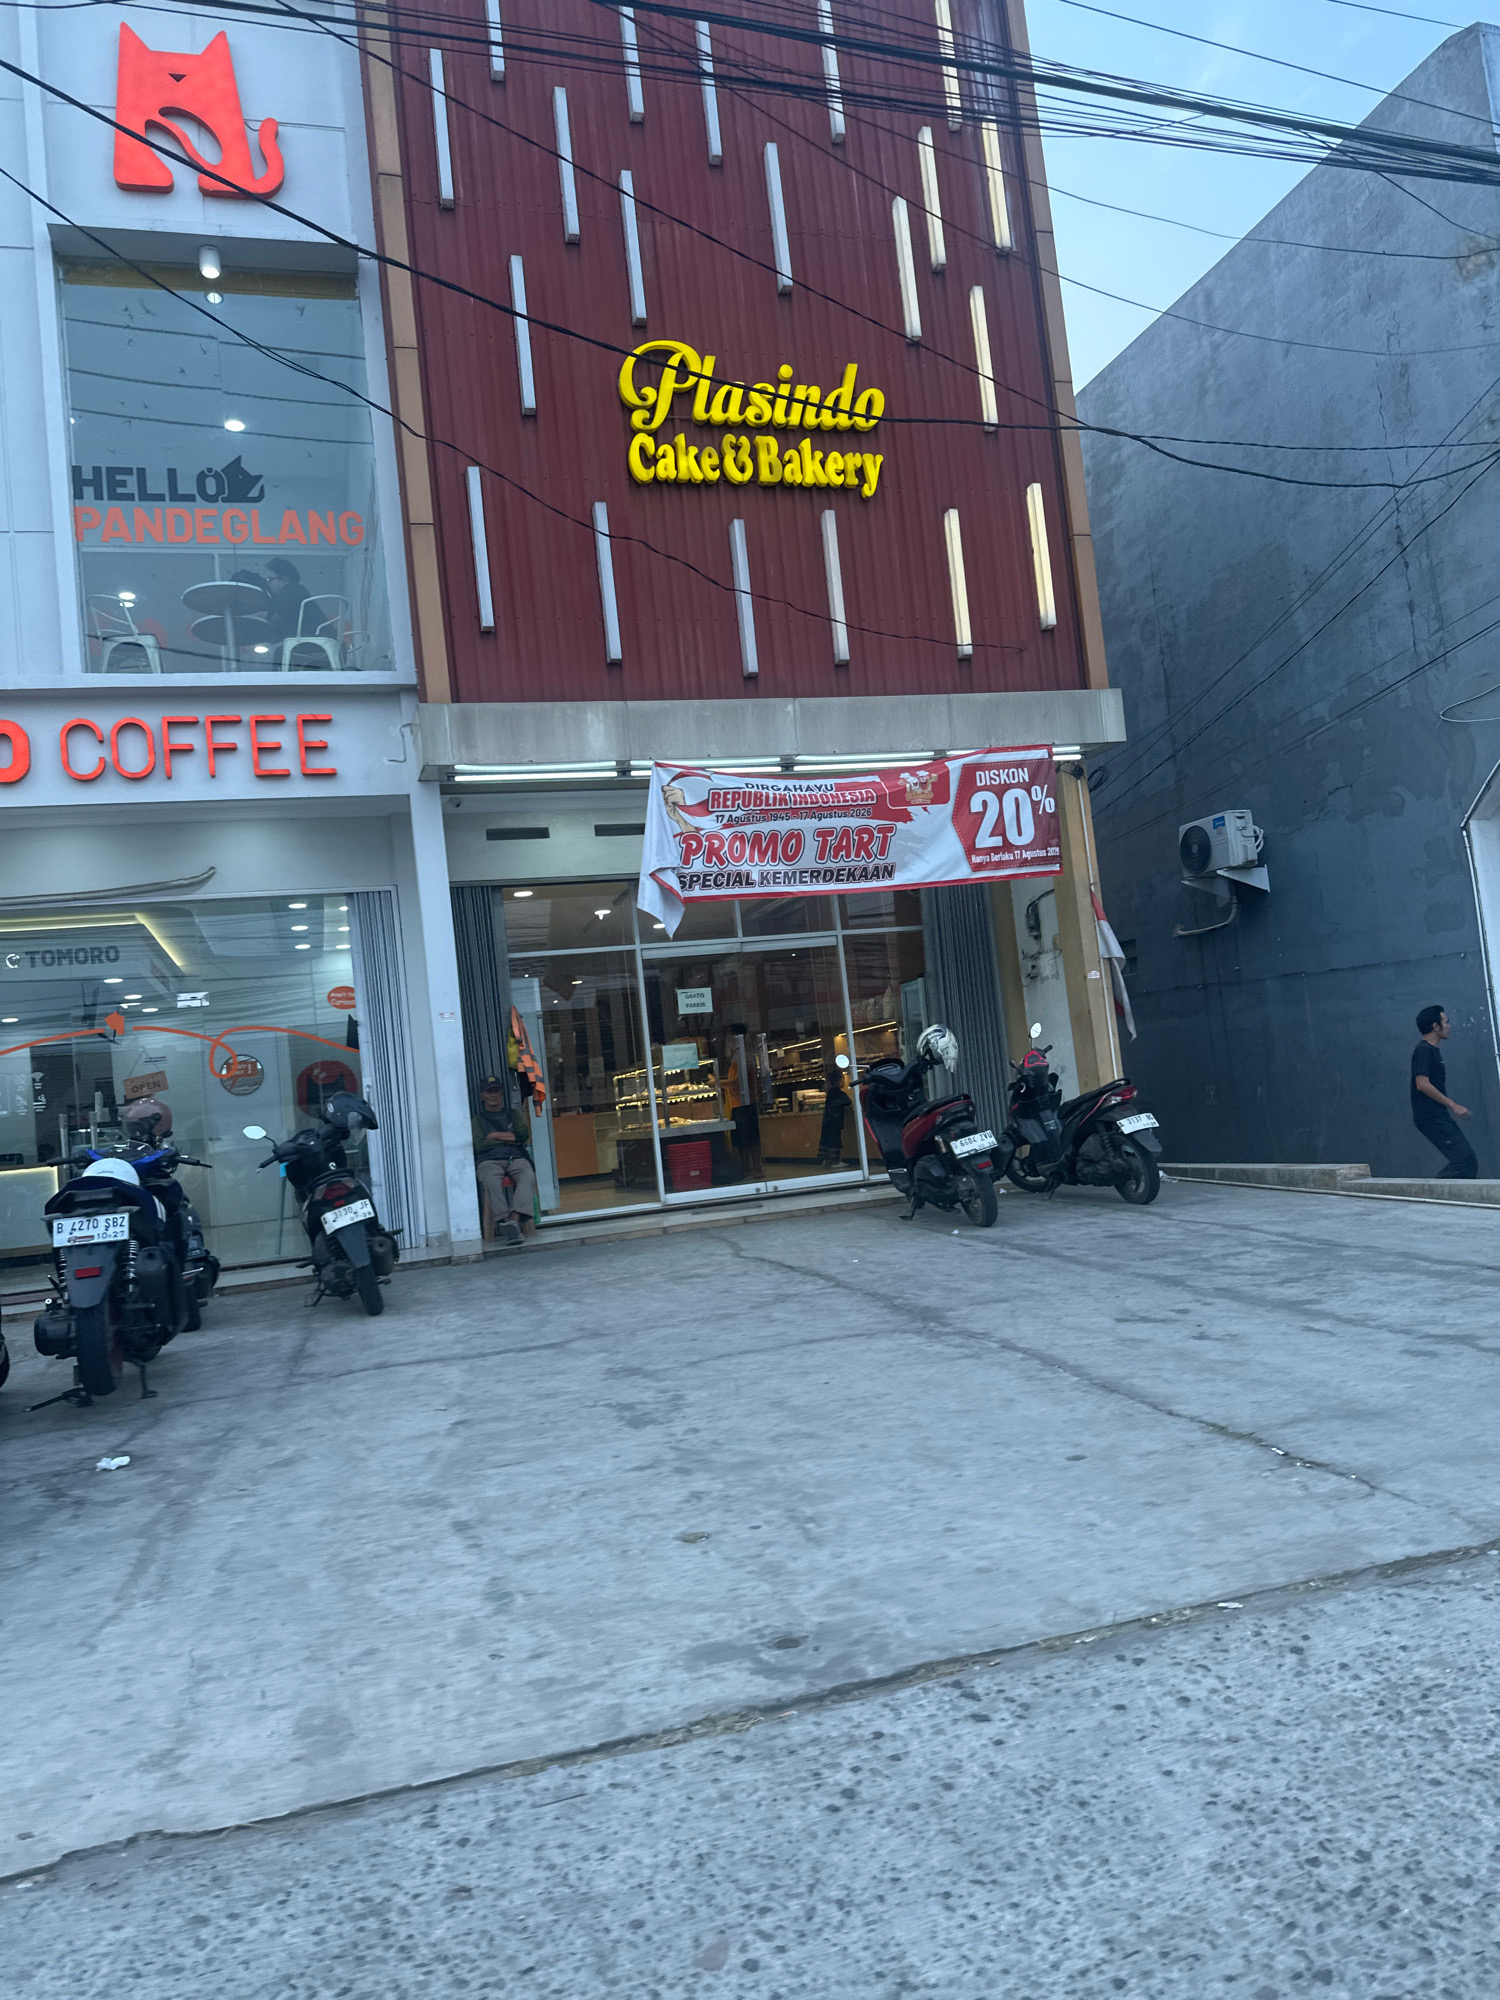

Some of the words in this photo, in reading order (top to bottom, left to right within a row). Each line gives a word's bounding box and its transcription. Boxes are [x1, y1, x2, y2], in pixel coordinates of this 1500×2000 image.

[619, 340, 885, 433] Plasindo
[72, 465, 228, 503] HELLO
[73, 506, 365, 546] PANDEGLANG
[60, 714, 337, 781] COFFEE
[745, 782, 834, 793] DIRGAHAYU
[976, 767, 1030, 786] DISKON
[710, 790, 790, 810] REPUBLIK
[791, 789, 876, 807] INDONESIA
[715, 814, 725, 824] 17
[727, 813, 767, 825] Agustus
[769, 812, 791, 821] 1945
[800, 811, 809, 820] 17
[810, 810, 847, 821] Agustus
[850, 808, 872, 817] 2026
[970, 784, 1056, 848] 20%
[680, 830, 803, 868] PROMO
[815, 824, 896, 863] TART
[1014, 850, 1021, 859] 17
[1022, 849, 1047, 860] Agustus
[679, 869, 755, 891] SPECIAL
[758, 863, 896, 887] KEMERDEKAAN
[25, 946, 120, 968] TOMORO
[131, 1080, 162, 1093] OPEN
[56, 1222, 64, 1233] B
[70, 1218, 99, 1232] 4270
[104, 1216, 126, 1229] SBZ
